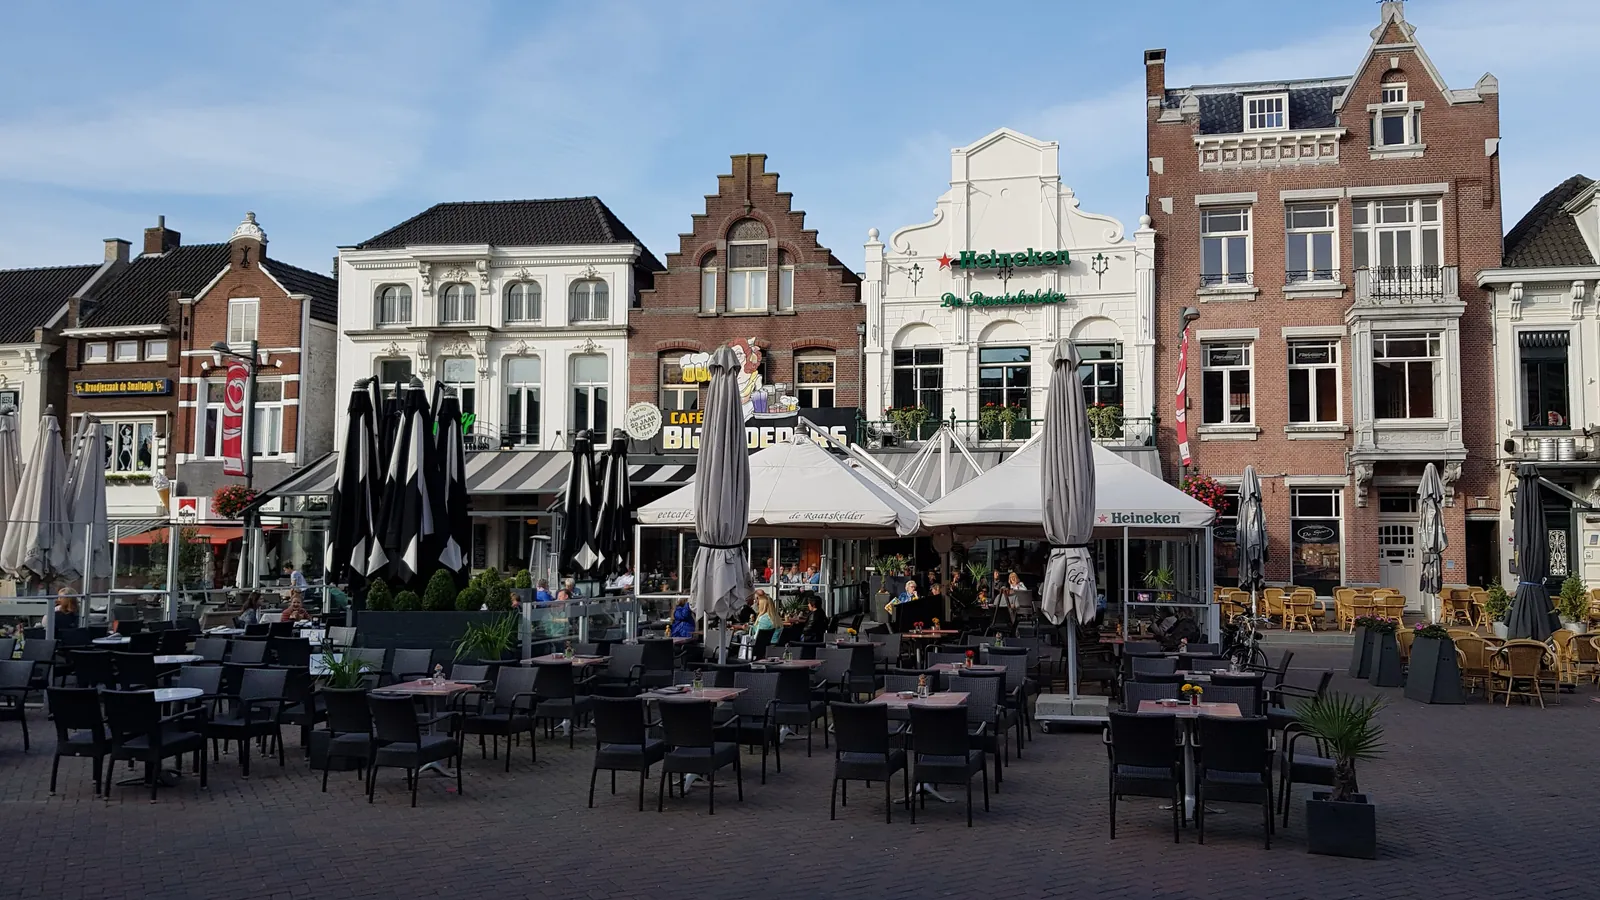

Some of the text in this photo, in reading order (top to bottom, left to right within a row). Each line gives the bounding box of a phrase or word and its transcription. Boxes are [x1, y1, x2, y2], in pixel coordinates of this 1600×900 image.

[959, 248, 1071, 269] Heineken
[940, 288, 1067, 308] De Raatskelder
[640, 415, 656, 425] JAAR
[670, 410, 704, 424] CAFÉ
[635, 421, 655, 433] FEEST
[788, 512, 800, 520] de
[804, 510, 866, 521] Raatskelder
[1111, 511, 1181, 524] Heineken
